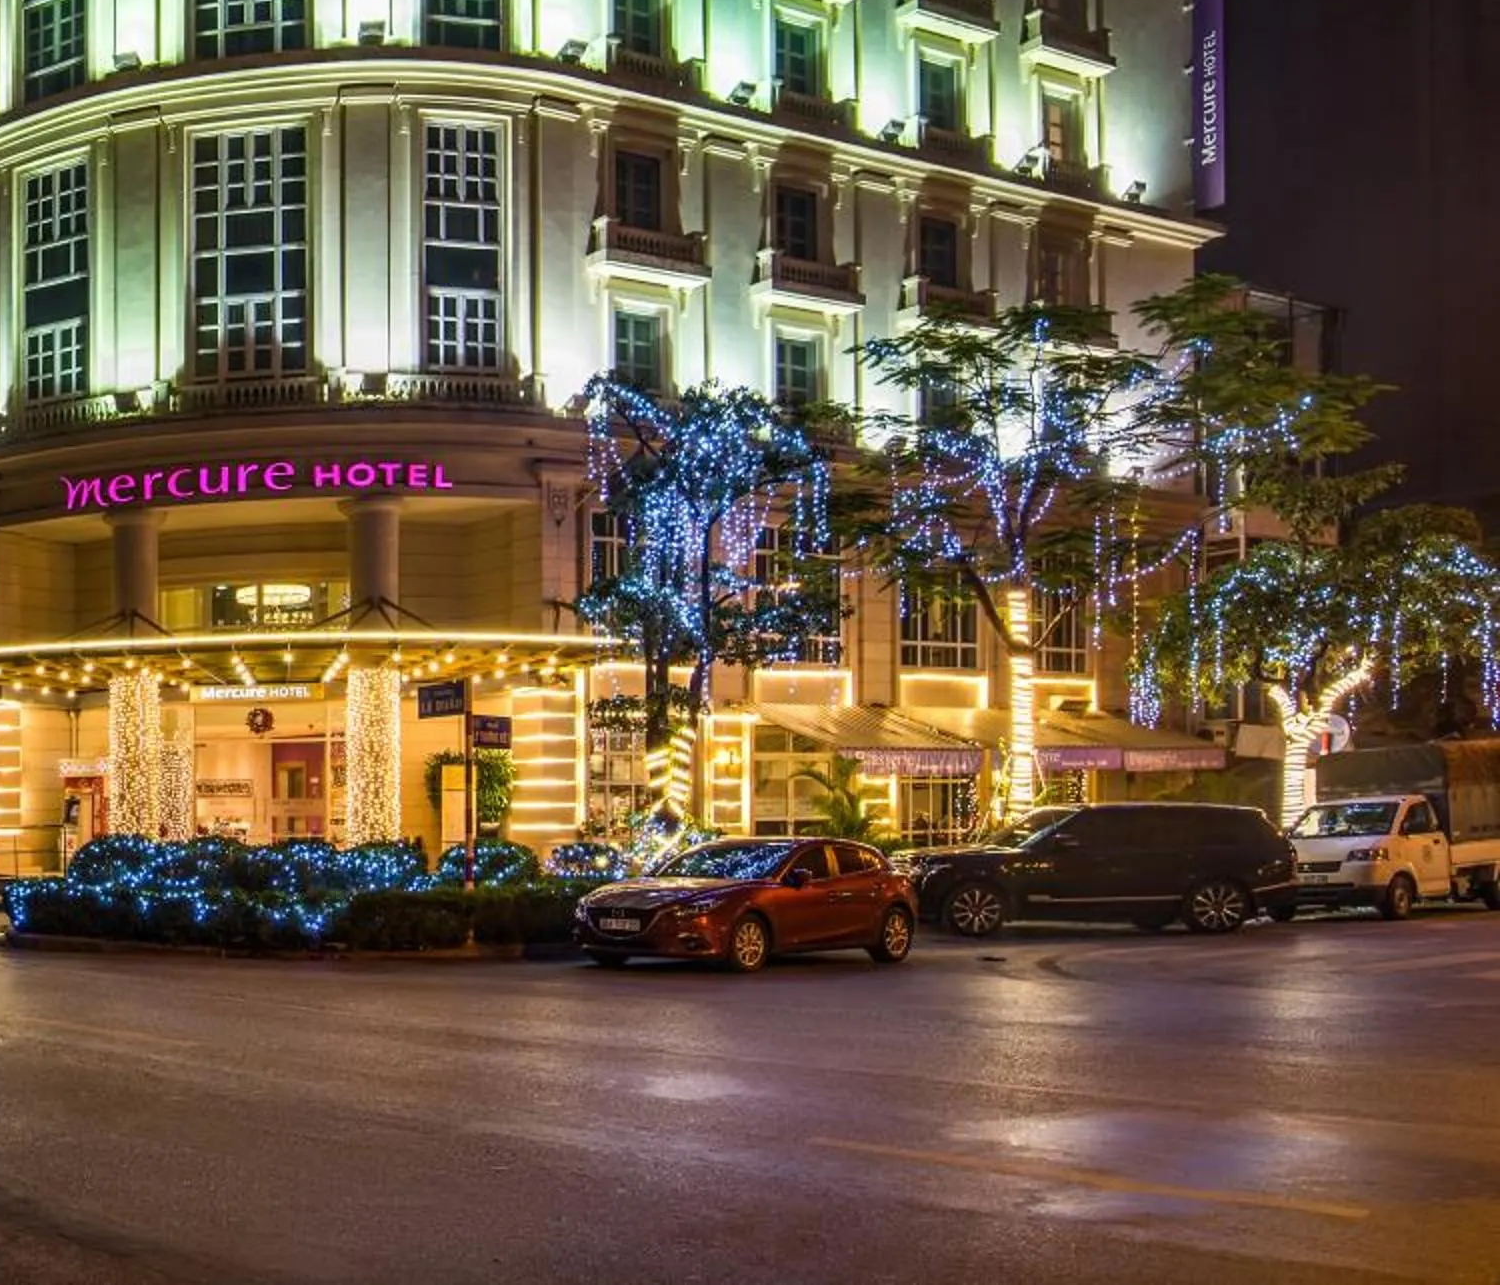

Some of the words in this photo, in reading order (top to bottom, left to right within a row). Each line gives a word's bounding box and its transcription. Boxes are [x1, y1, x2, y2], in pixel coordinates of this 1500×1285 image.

[1203, 30, 1217, 77] HOTEL
[1201, 78, 1218, 167] Mercure
[314, 461, 453, 489] HOTEL
[202, 687, 266, 700] Mercure
[270, 686, 309, 698] HOTEL
